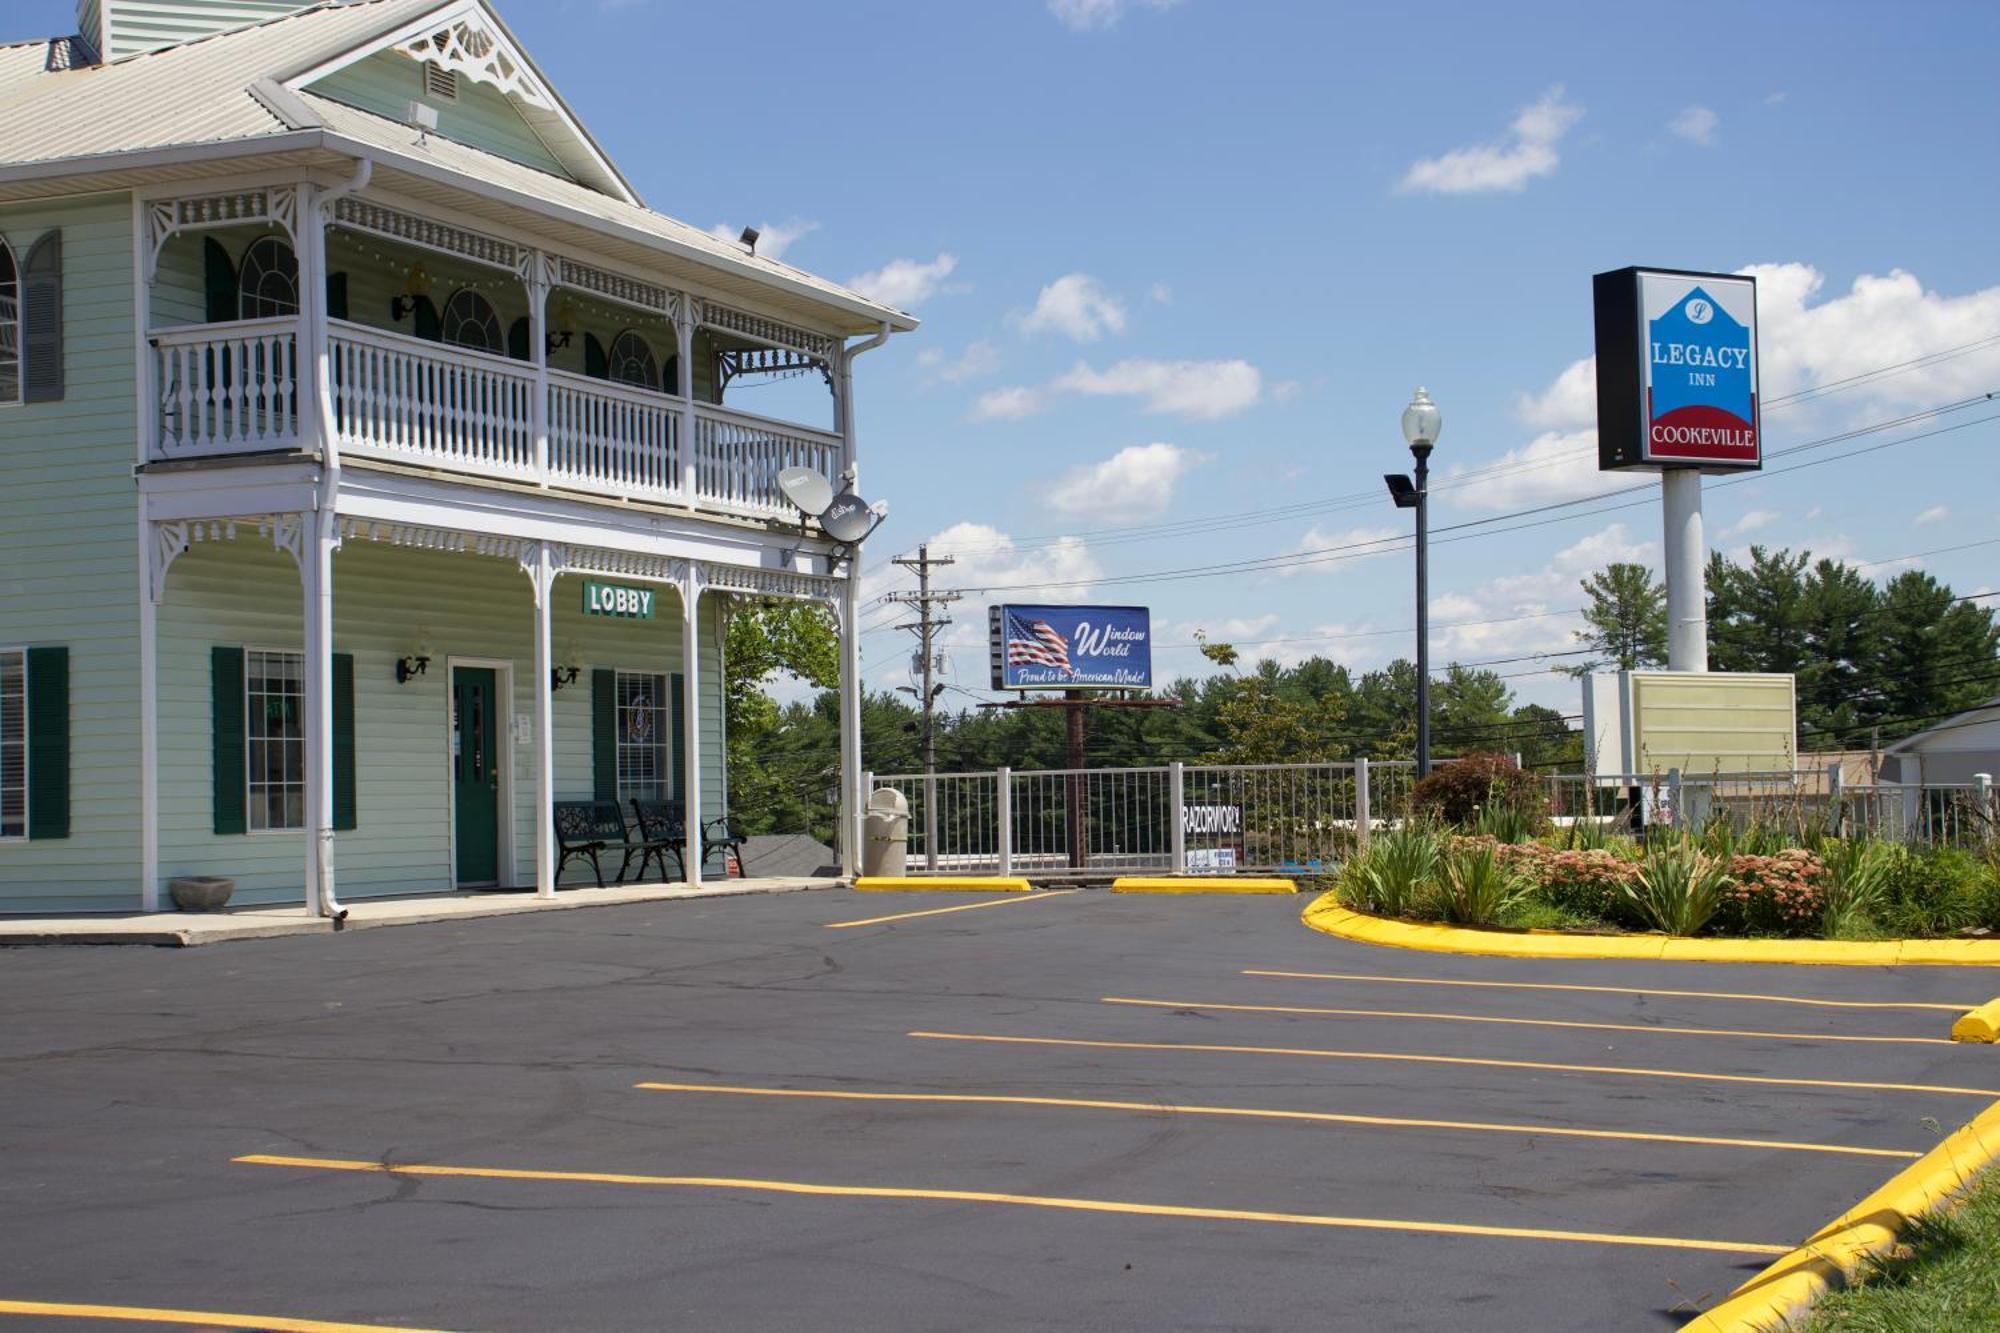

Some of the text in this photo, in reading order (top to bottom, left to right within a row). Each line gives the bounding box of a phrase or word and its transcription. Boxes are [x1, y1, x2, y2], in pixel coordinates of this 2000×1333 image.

[1652, 342, 1748, 369] LEGACY
[1688, 372, 1716, 387] INN
[1651, 425, 1754, 447] COOKEVILLE
[590, 585, 650, 614] LOBBY
[1075, 621, 1145, 657] Window
[1018, 668, 1046, 683] Proud
[1048, 669, 1055, 682] to
[1057, 668, 1068, 682] be
[1071, 667, 1113, 684] American
